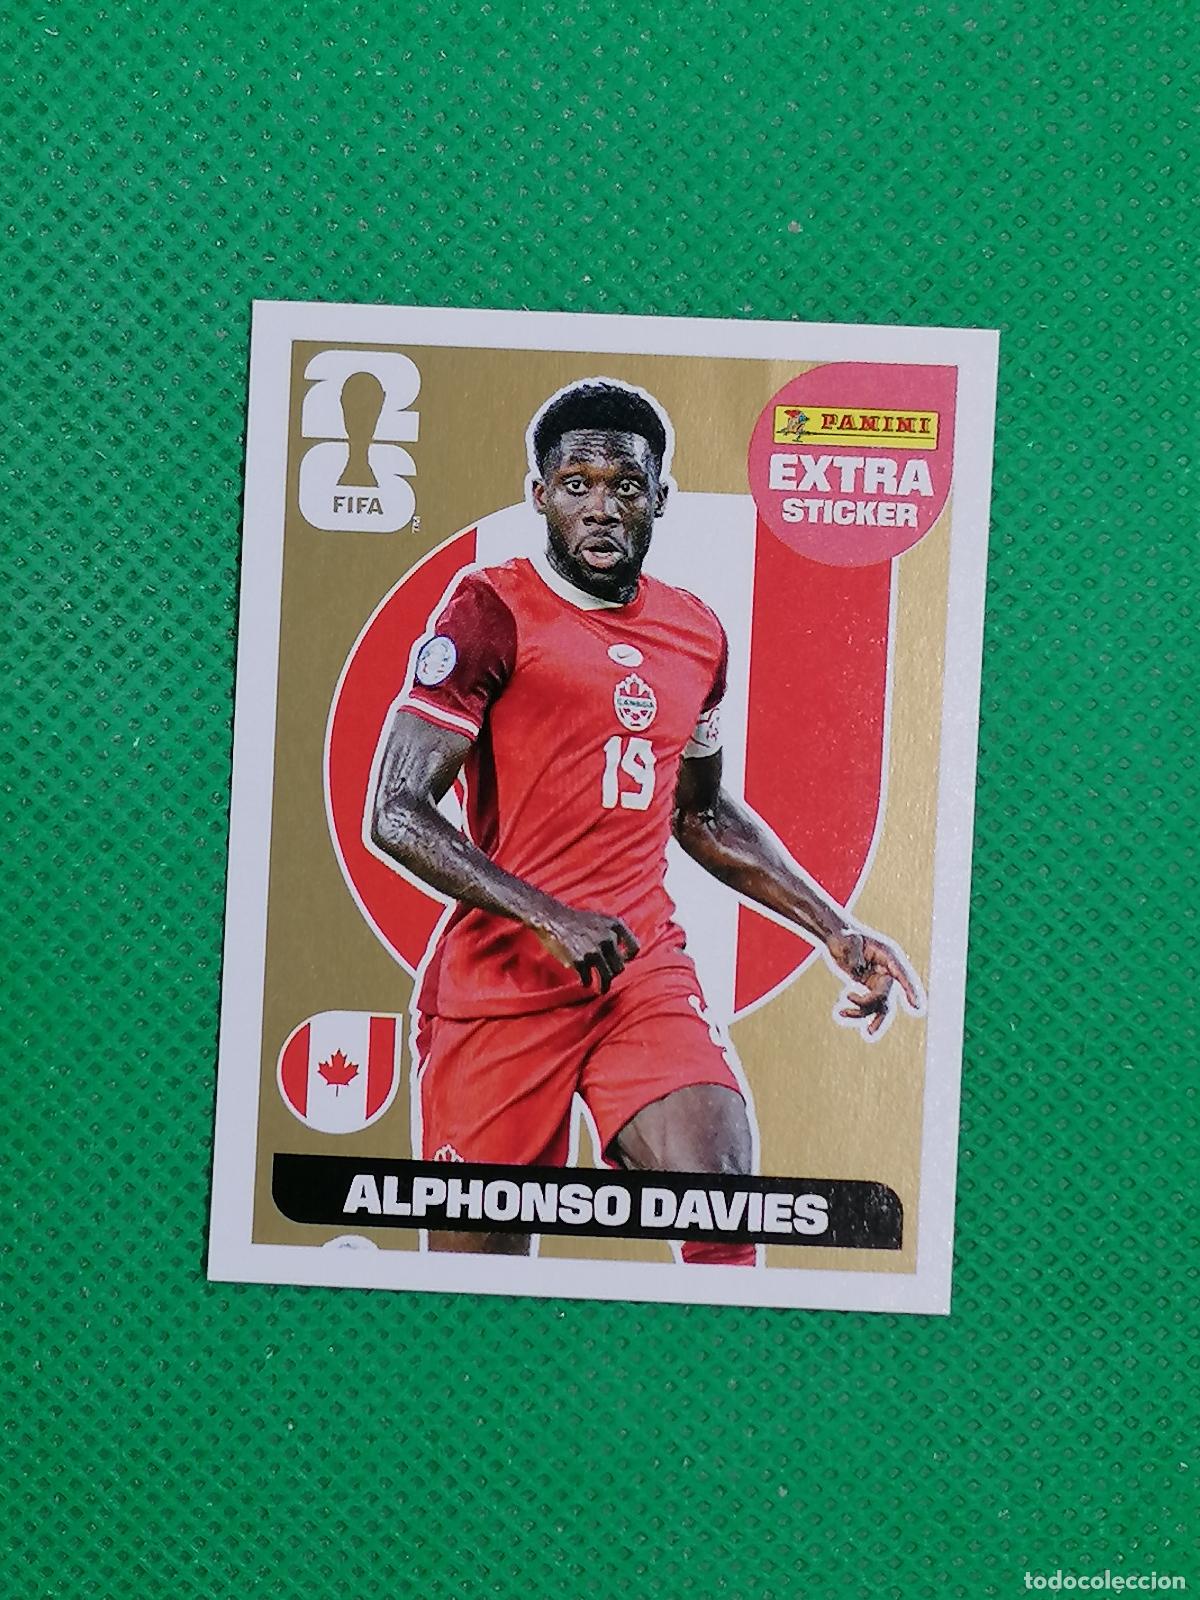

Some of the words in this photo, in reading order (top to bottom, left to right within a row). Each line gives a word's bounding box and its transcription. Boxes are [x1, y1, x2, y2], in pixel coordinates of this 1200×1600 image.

[821, 413, 931, 434] PANINI
[768, 453, 934, 497] EXTRA
[333, 496, 384, 516] FIFA
[781, 498, 919, 529] STICKER
[602, 735, 657, 811] 19
[342, 1174, 631, 1227] ALPHONSO
[640, 1187, 829, 1235] DAVIES
